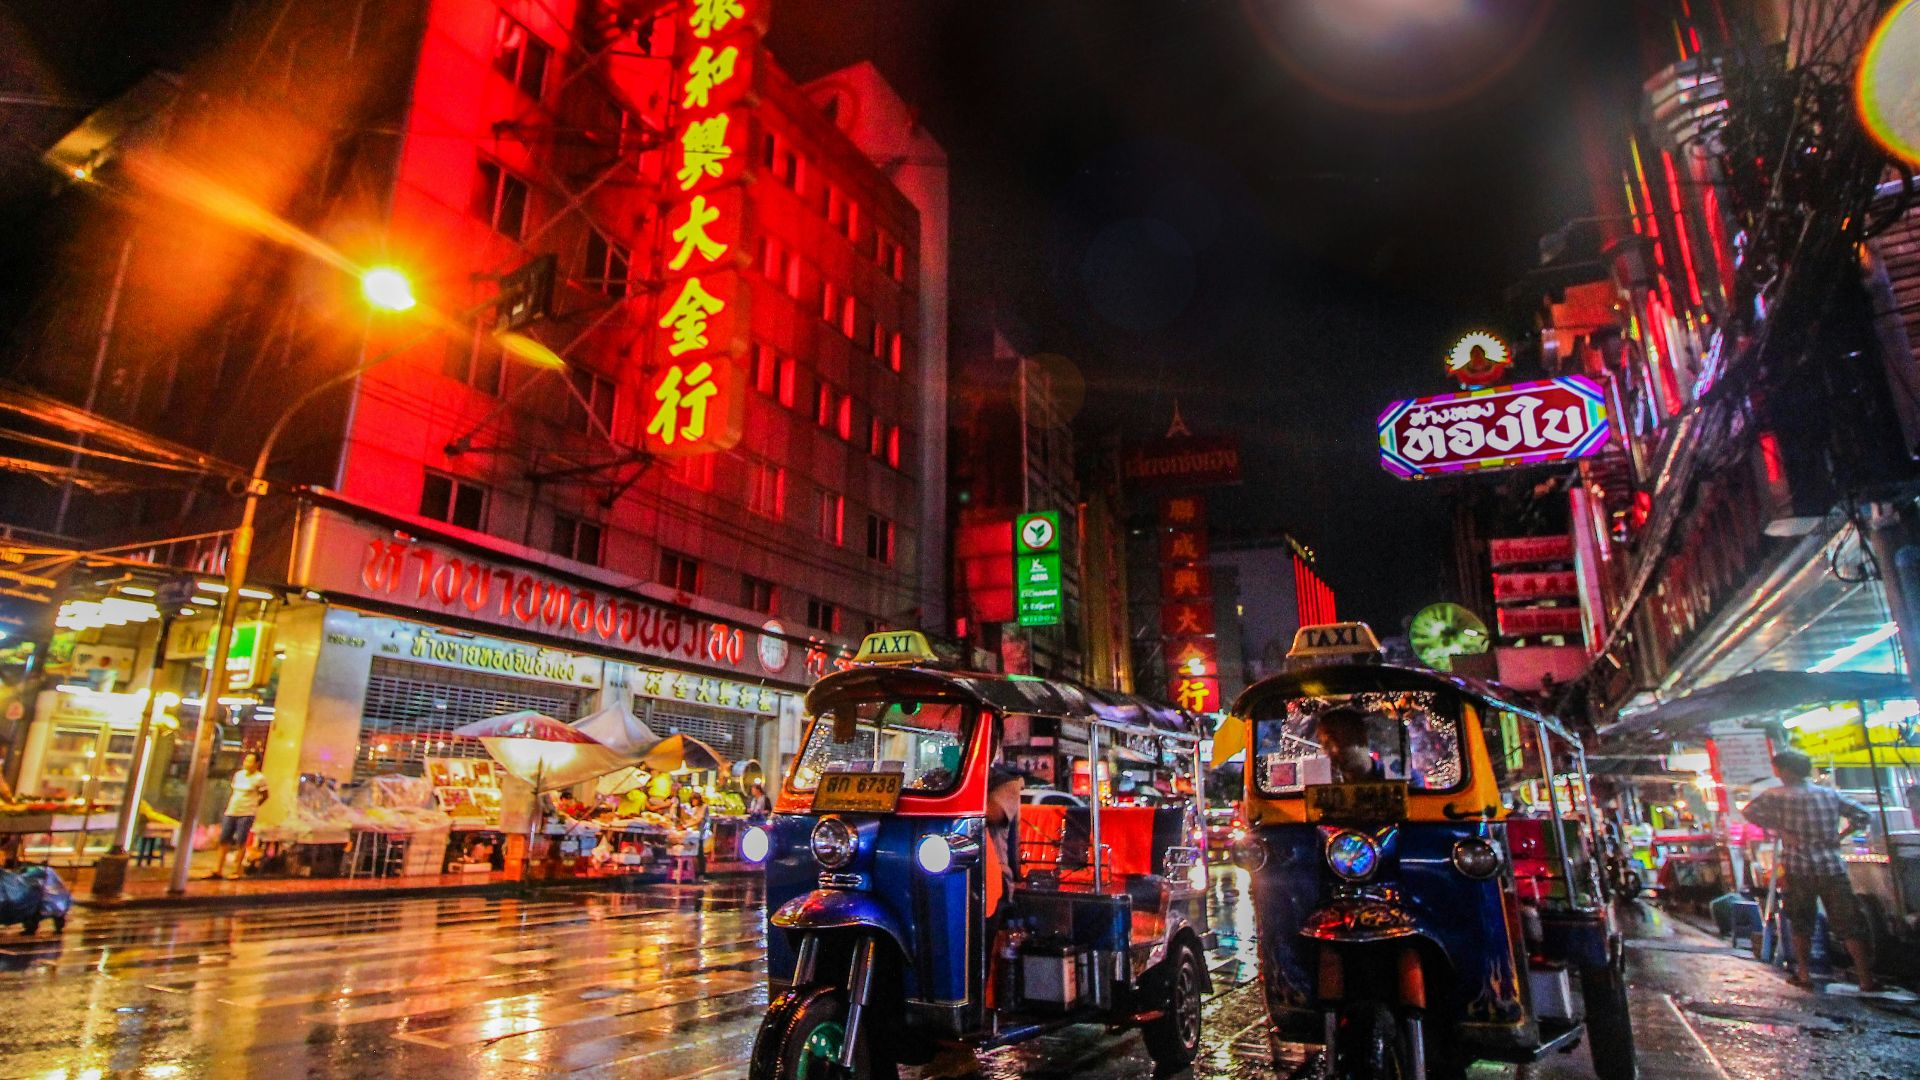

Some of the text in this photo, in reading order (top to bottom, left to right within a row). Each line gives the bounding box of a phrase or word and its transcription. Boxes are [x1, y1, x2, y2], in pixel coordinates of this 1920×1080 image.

[1402, 395, 1584, 462] ทองใบ
[869, 634, 911, 654] TAXI
[1305, 626, 1358, 647] TAXI
[856, 776, 896, 794] 6738
